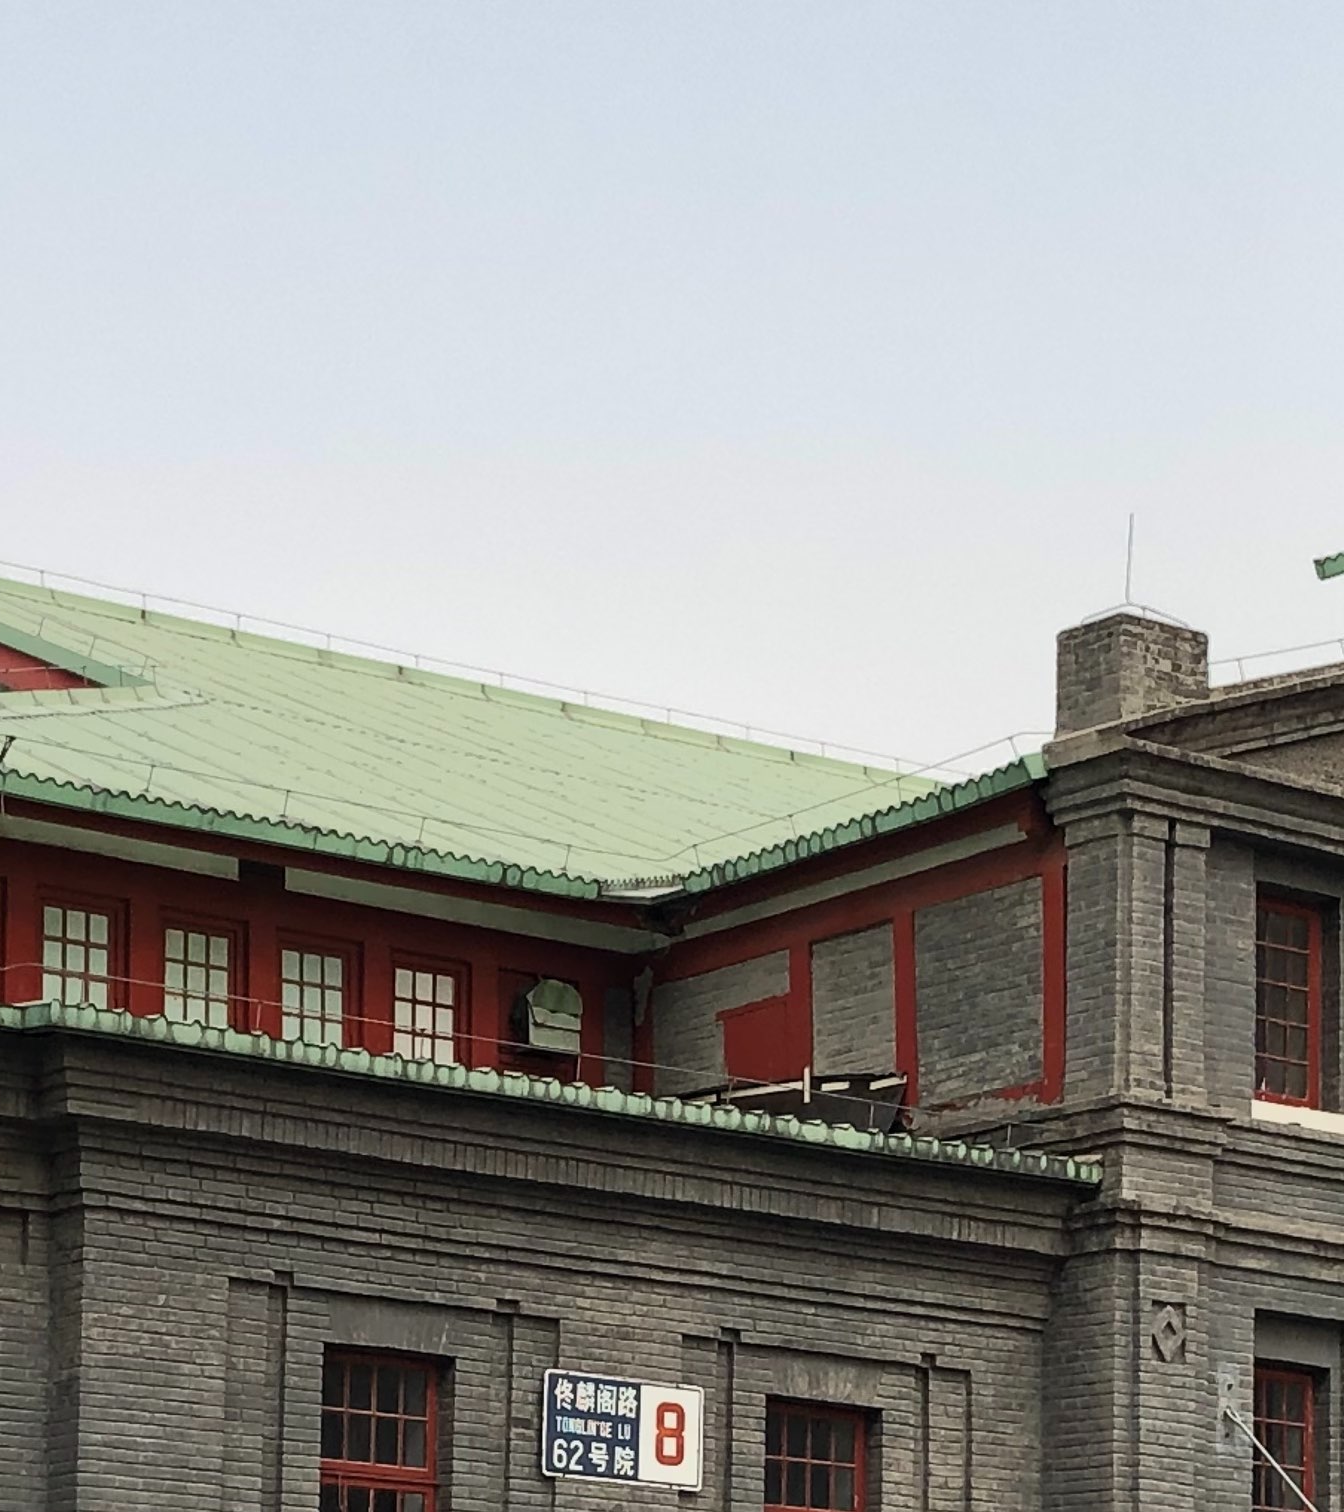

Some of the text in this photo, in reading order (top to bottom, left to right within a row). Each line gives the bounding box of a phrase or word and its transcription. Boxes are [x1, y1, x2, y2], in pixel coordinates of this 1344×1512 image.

[554, 1378, 638, 1418] 佟麟阁路
[617, 1422, 631, 1440] LU
[655, 1401, 685, 1466] 8
[553, 1438, 635, 1476] 62号院
